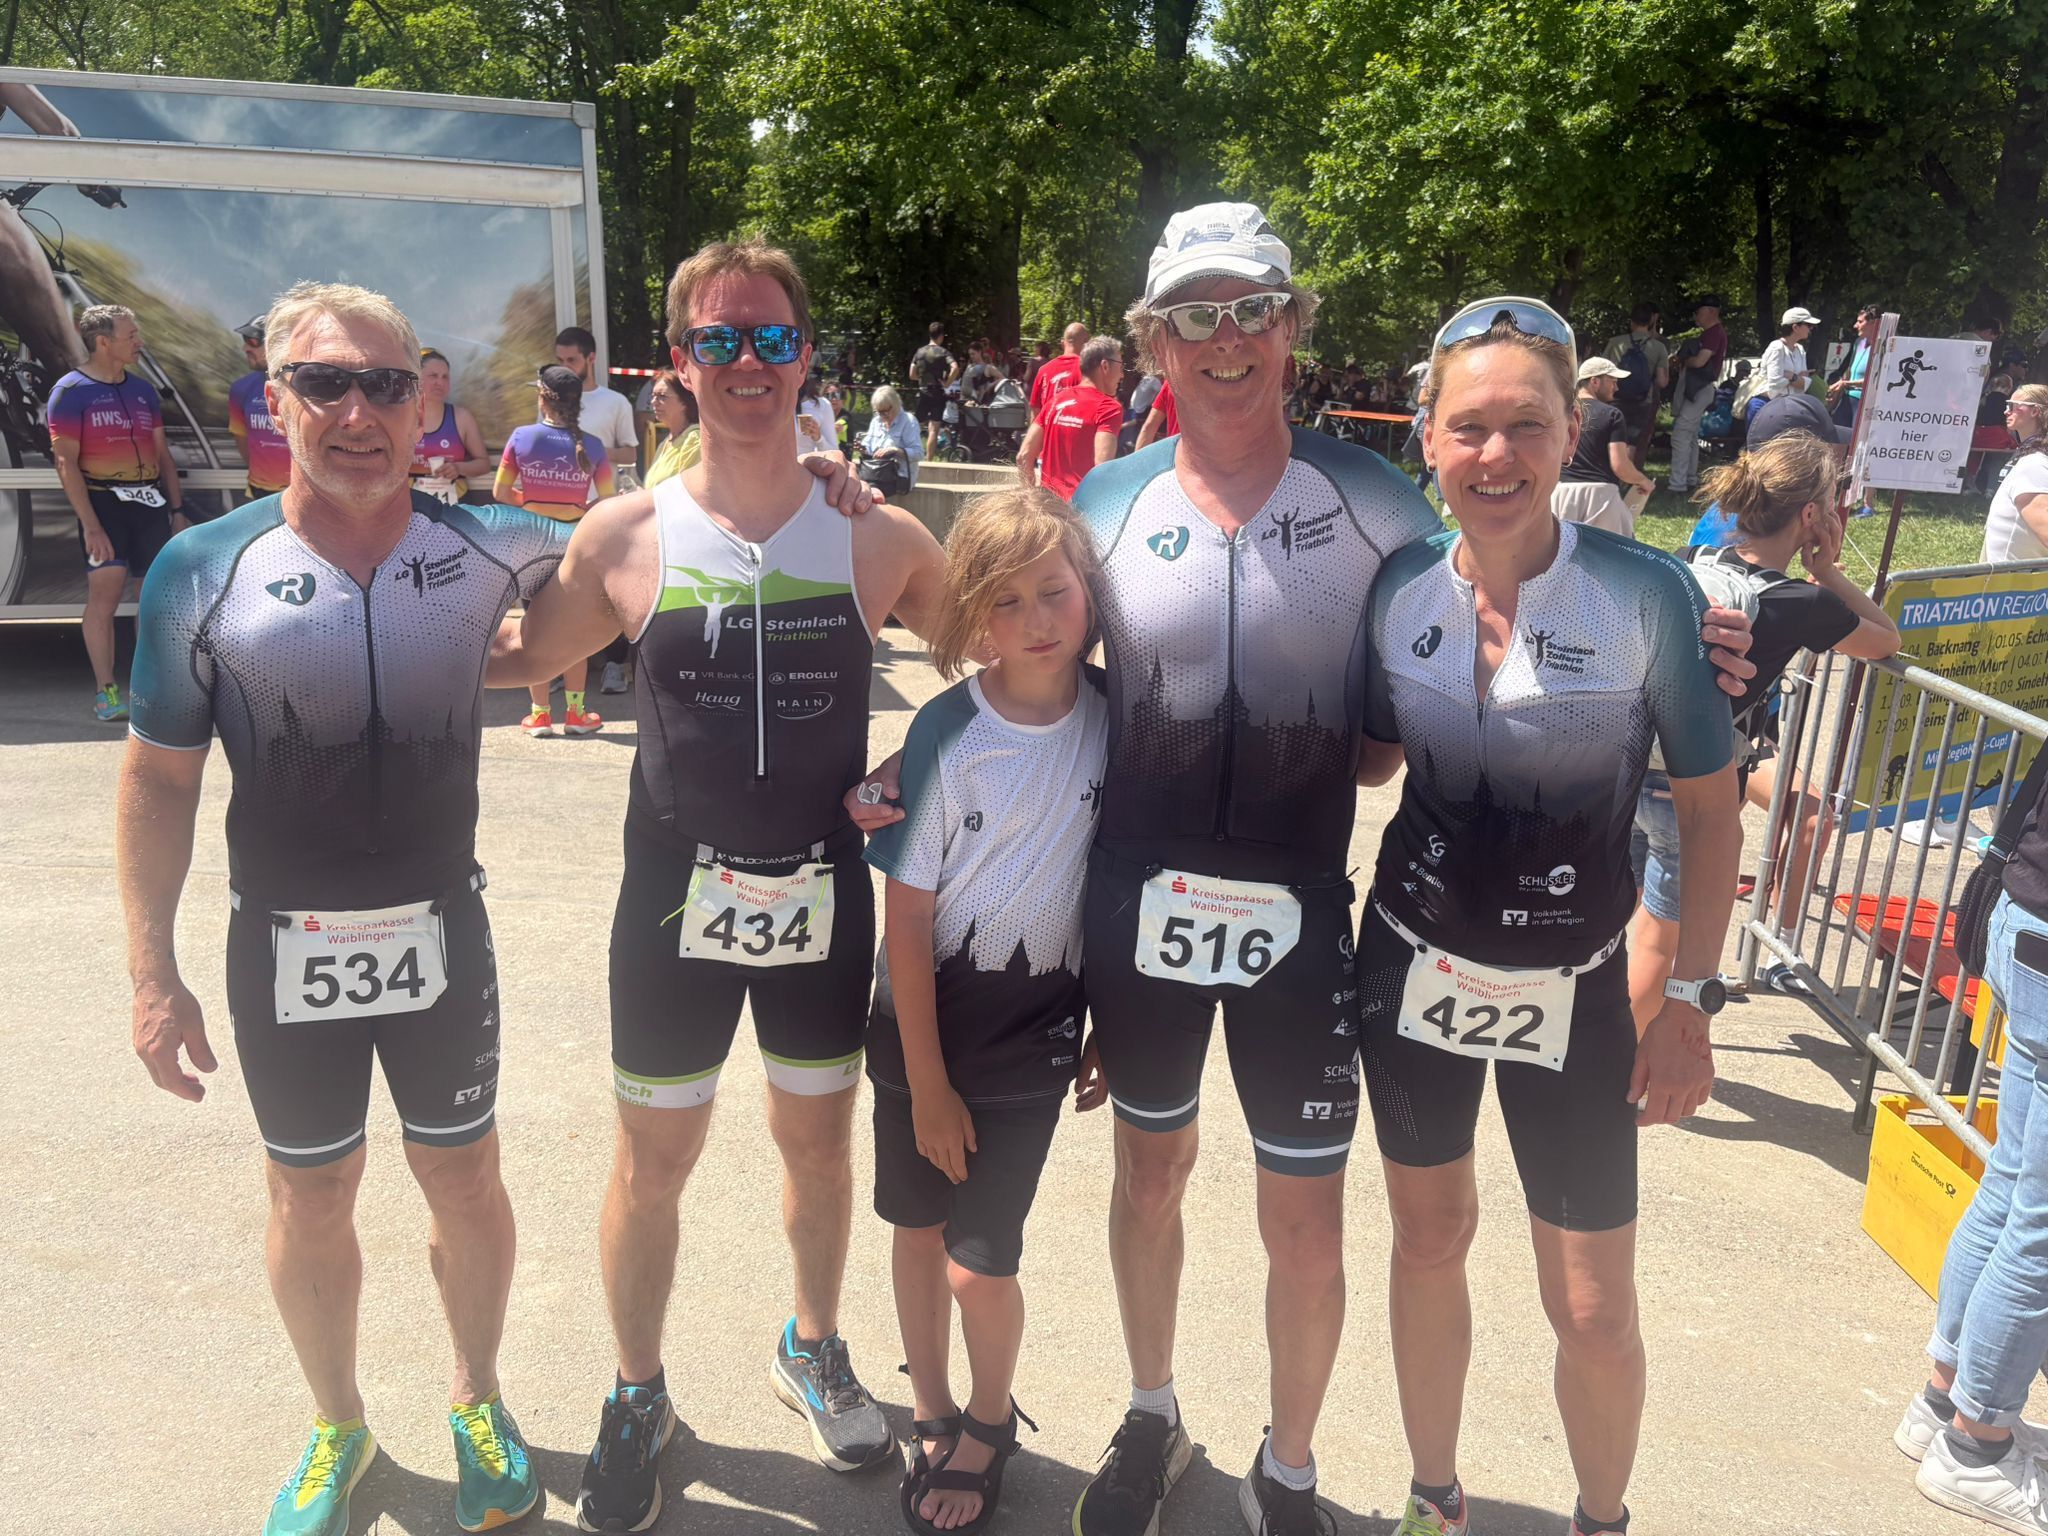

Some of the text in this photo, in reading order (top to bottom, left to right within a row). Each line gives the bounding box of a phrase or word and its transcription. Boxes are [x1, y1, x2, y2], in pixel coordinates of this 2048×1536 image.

[91, 411, 123, 427] HWS
[250, 413, 274, 430] HWS
[1877, 410, 1969, 426] RANSPONDER
[1901, 430, 1928, 442] hier
[1869, 447, 1934, 461] ABGEBEN
[522, 467, 589, 482] TRIATHLON
[1294, 504, 1343, 531] Steinlach
[1262, 523, 1333, 542] LG Zollern
[1295, 535, 1335, 552] Triathlon
[424, 545, 468, 571] Steinlach
[395, 561, 462, 582] LG Zollern
[427, 571, 466, 590] Triathlon
[1903, 592, 2048, 625] TRIATHLON REGIO
[726, 615, 847, 631] LG Steinlach
[766, 631, 828, 642] Triathlon
[1546, 641, 1595, 656] Steinlach
[1927, 640, 1981, 657] Backnang
[1546, 650, 1584, 664] Zollern
[1545, 659, 1584, 674] Triathlon
[701, 671, 714, 680] VR
[717, 672, 740, 680] Bank
[789, 672, 838, 681] EROGLU
[695, 692, 741, 706] Haug
[777, 699, 822, 708] HAIN
[1080, 793, 1092, 801] LG
[728, 852, 805, 865] VELOCHAMPION
[1192, 887, 1274, 906] Kreissparkasse
[1190, 899, 1253, 918] Waiblingen
[1533, 907, 1571, 918] Volksbank
[1542, 918, 1554, 926] der
[1557, 917, 1585, 926] Region
[327, 931, 396, 944] Waiblingen
[702, 906, 812, 956] 434
[1159, 915, 1274, 976] 516
[302, 946, 426, 1008] 534
[1457, 970, 1546, 992] Kreissparkasse
[1456, 979, 1521, 1000] Waiblingen
[1422, 995, 1544, 1053] 422
[1911, 1155, 1932, 1179] Deutsche
[1932, 1175, 1945, 1189] Post
